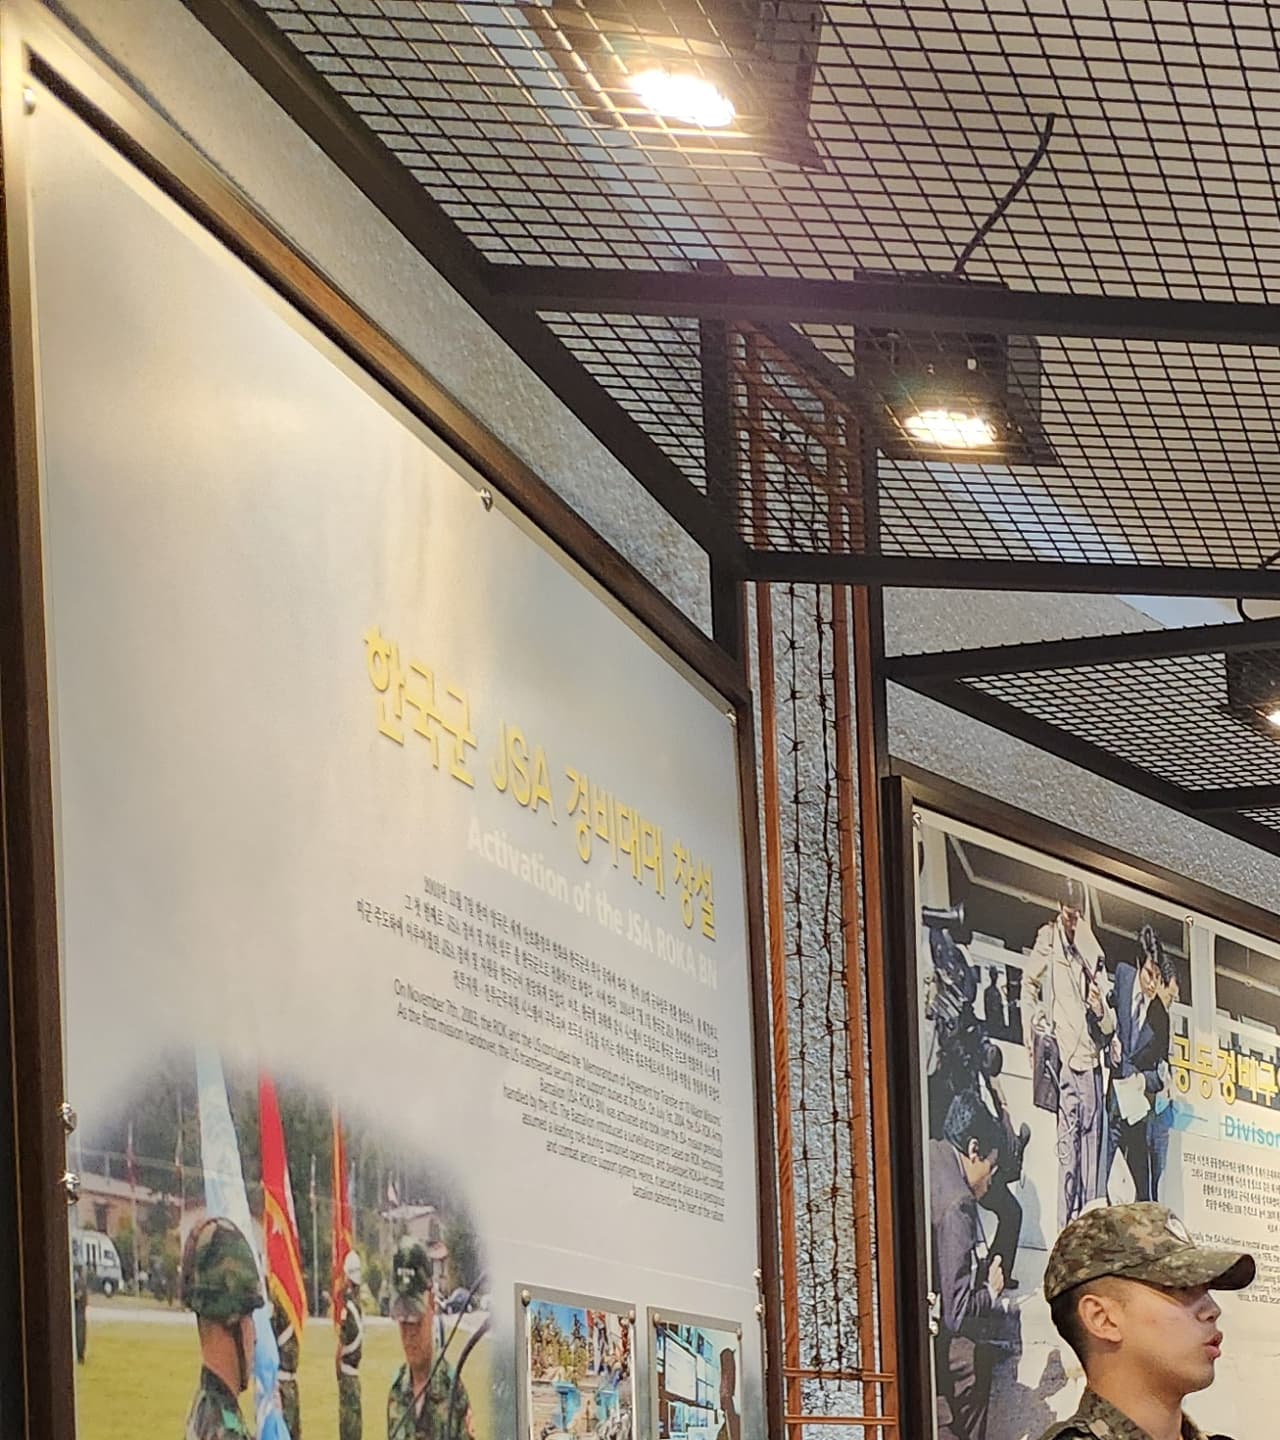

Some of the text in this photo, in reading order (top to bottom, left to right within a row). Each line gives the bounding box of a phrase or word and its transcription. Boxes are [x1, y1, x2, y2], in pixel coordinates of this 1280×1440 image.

[364, 625, 716, 942] 한국군 JSA 경비대대 창설
[468, 816, 718, 990] Activation of the JSA ROKA BN
